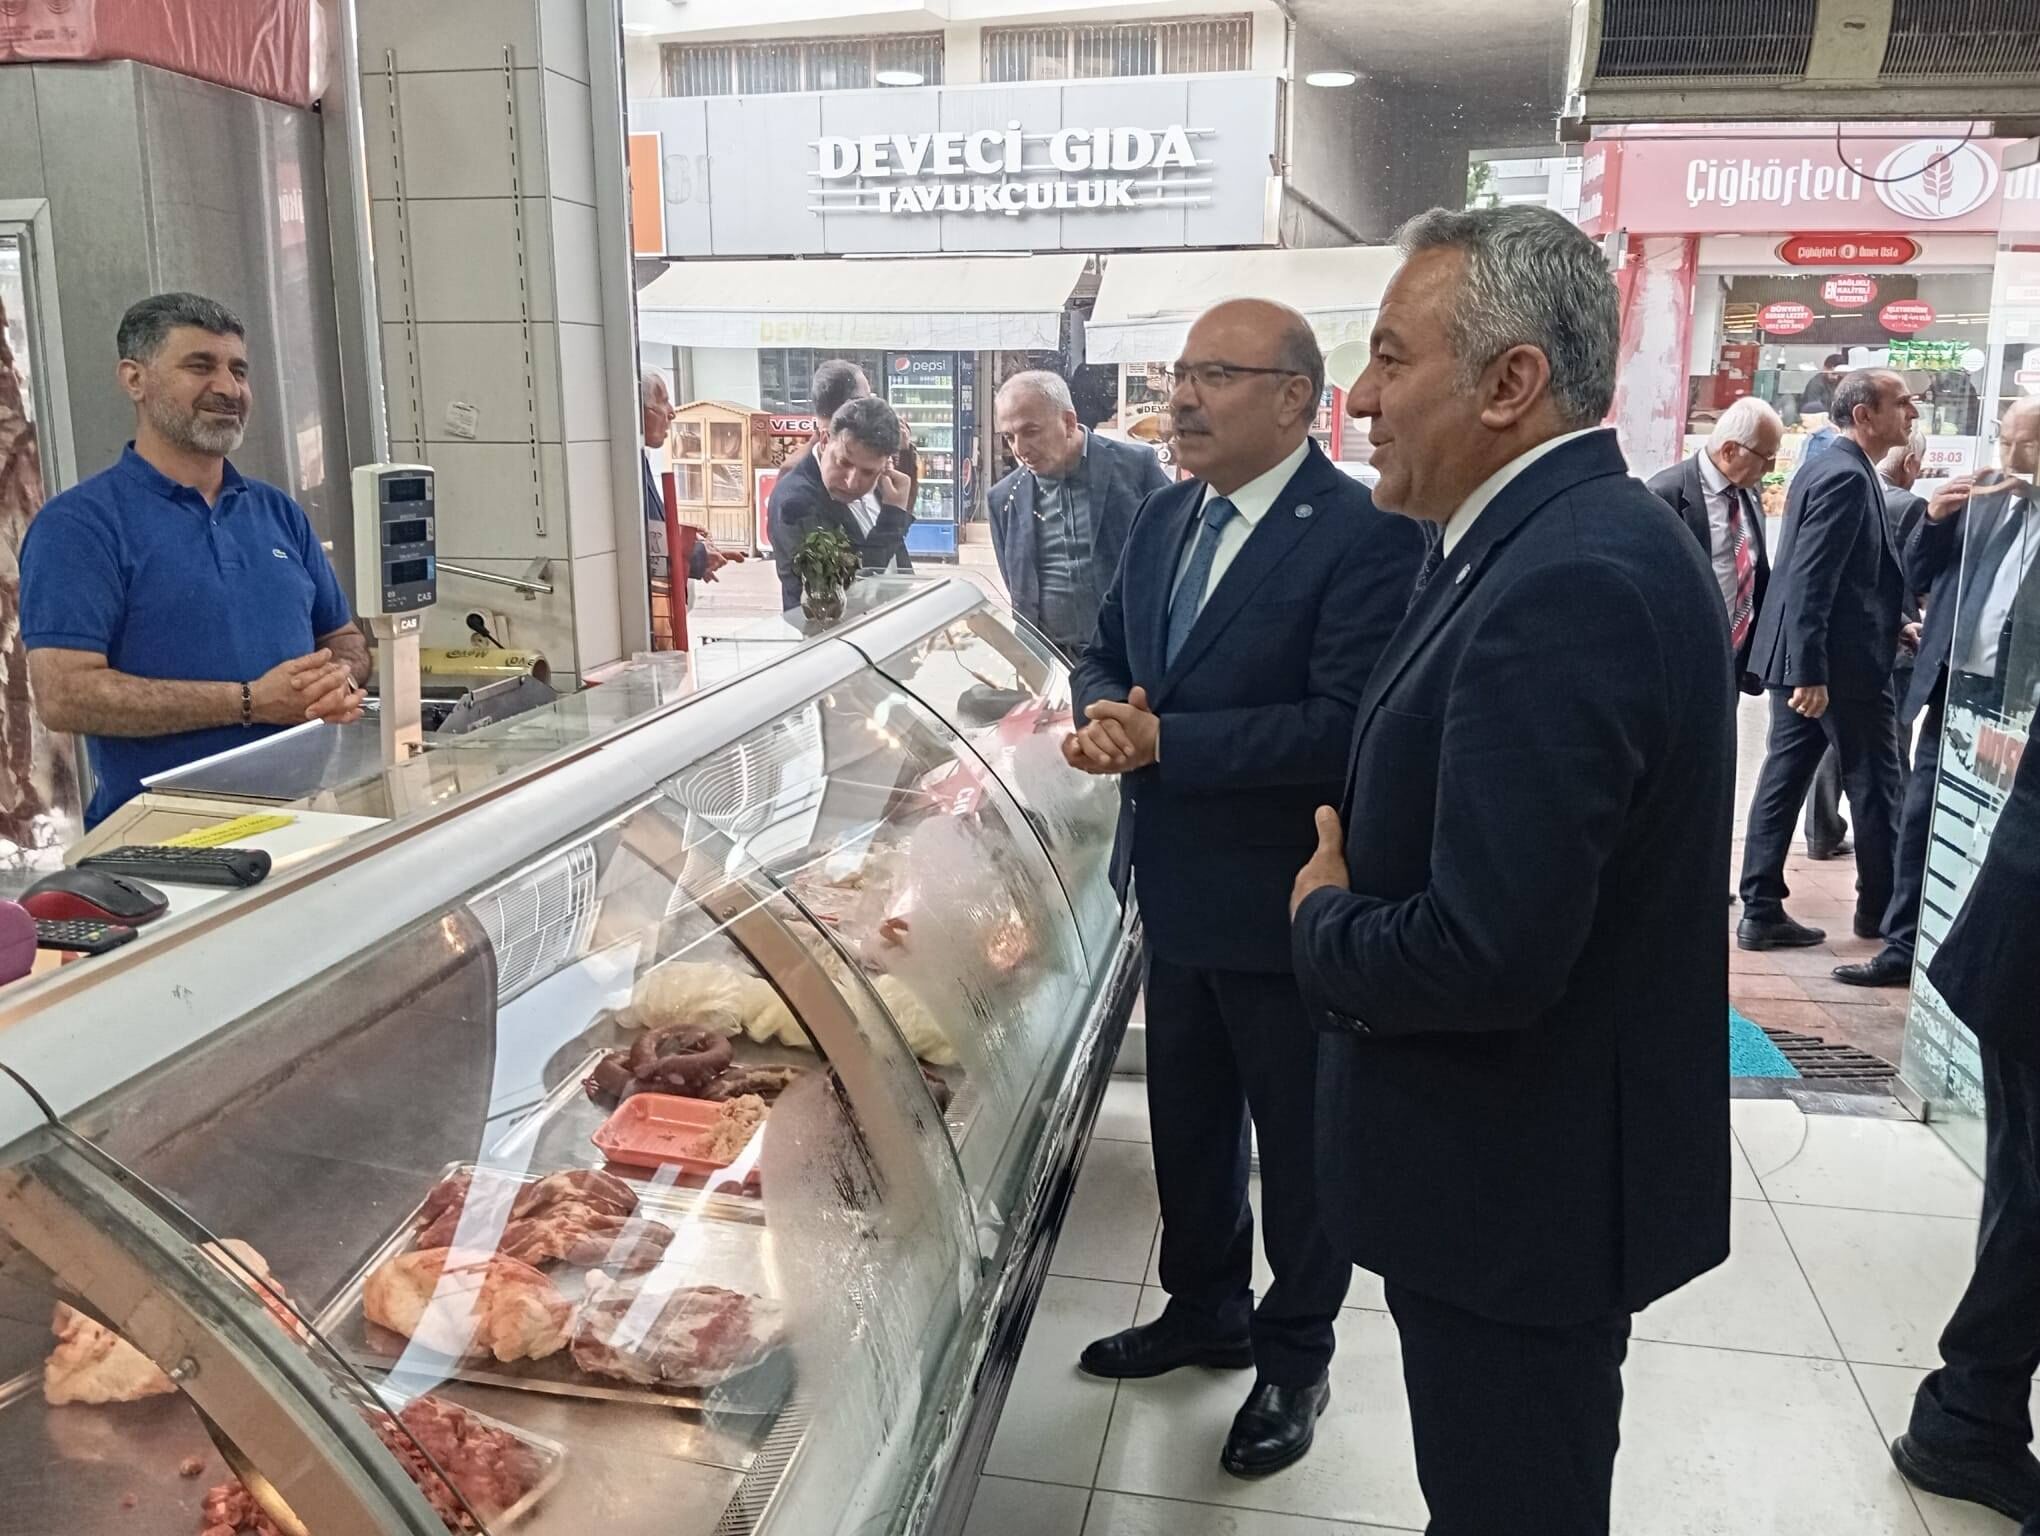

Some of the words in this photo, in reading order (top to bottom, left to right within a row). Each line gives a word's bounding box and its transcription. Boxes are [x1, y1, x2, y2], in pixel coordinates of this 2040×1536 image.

[819, 119, 1023, 179] DEVECİ
[1049, 124, 1198, 173] GIDA
[1686, 157, 1863, 208] Çiğköfteci
[876, 179, 1136, 216] TAVUKÇULUK
[912, 360, 946, 372] pepsi
[417, 592, 432, 602] CAS
[401, 618, 417, 630] CAS
